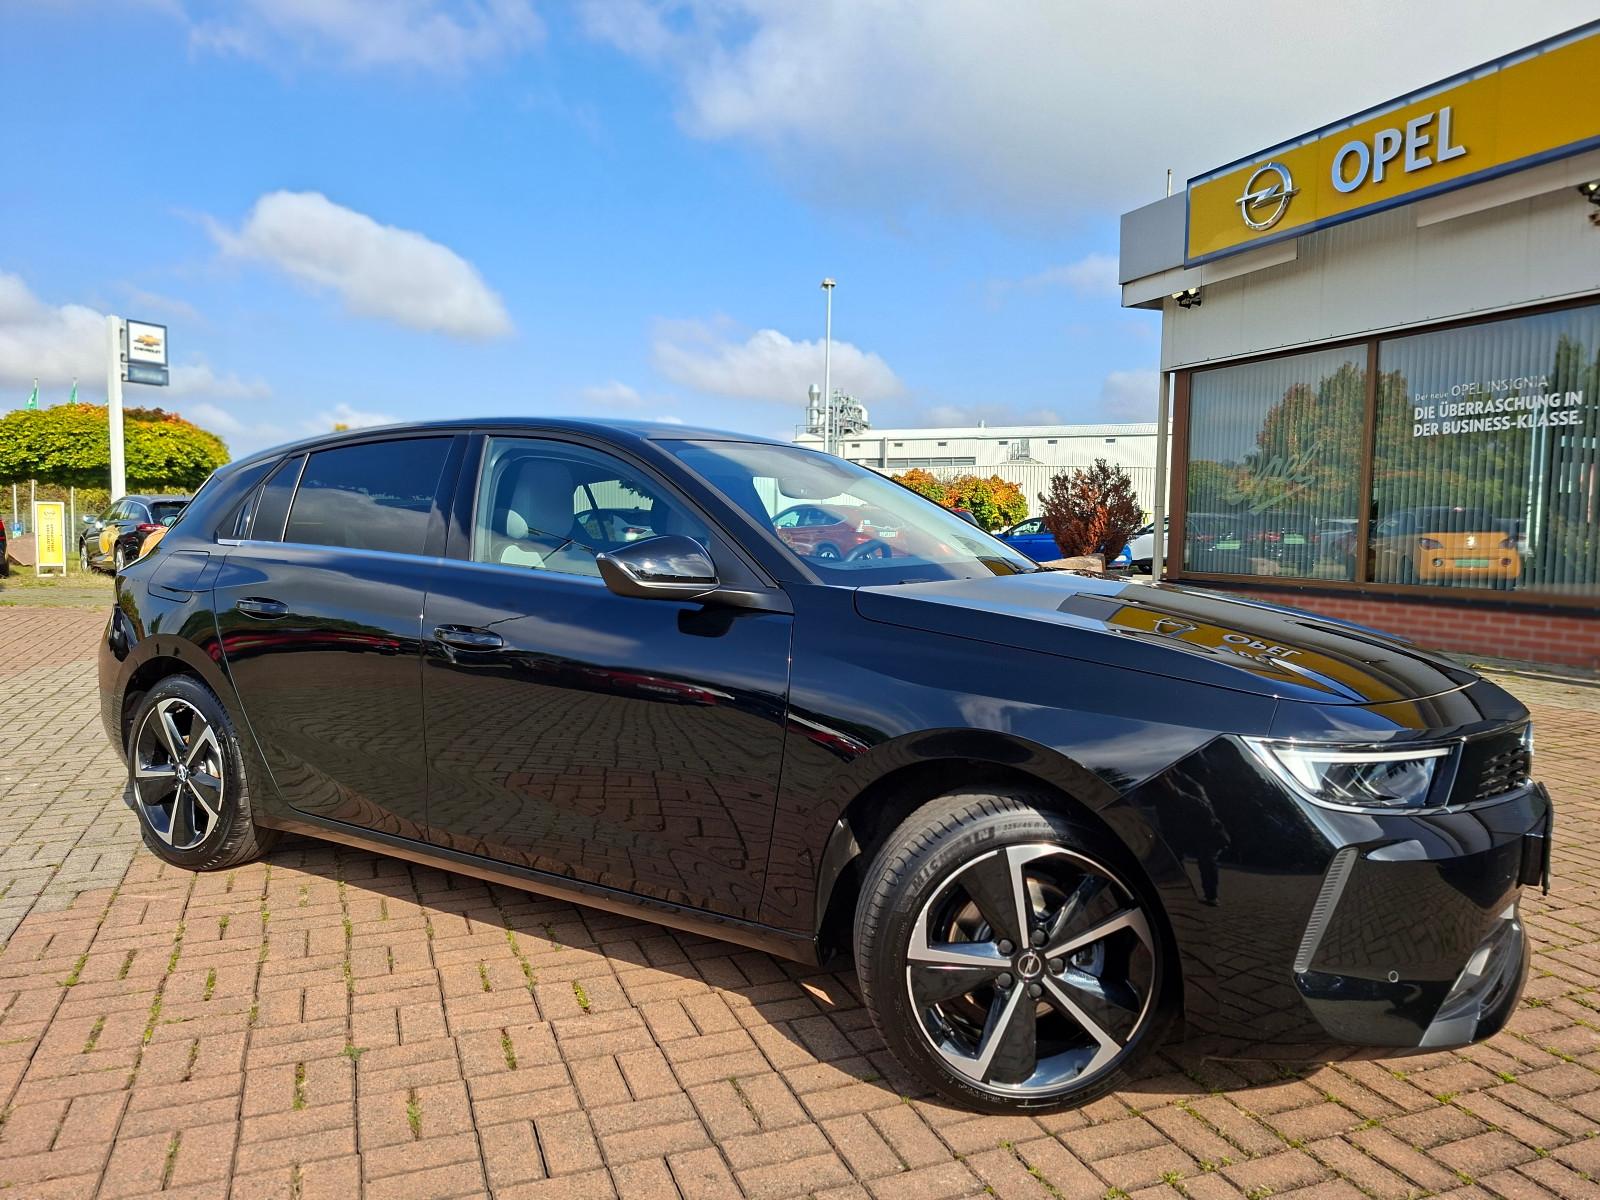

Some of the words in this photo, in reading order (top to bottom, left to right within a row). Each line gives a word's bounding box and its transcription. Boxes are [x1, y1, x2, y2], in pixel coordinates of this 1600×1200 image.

[1331, 106, 1467, 193] OPEL
[1415, 393, 1429, 402] Der
[1451, 382, 1484, 397] OPEL
[1487, 375, 1549, 393] INSIGNIA
[1414, 406, 1436, 420] DIE
[1440, 393, 1561, 417] ÜBERRASCHUNG
[1564, 391, 1583, 407] IN
[1413, 423, 1439, 437] DER
[1442, 410, 1584, 435] BUSINESS-KLASSE.
